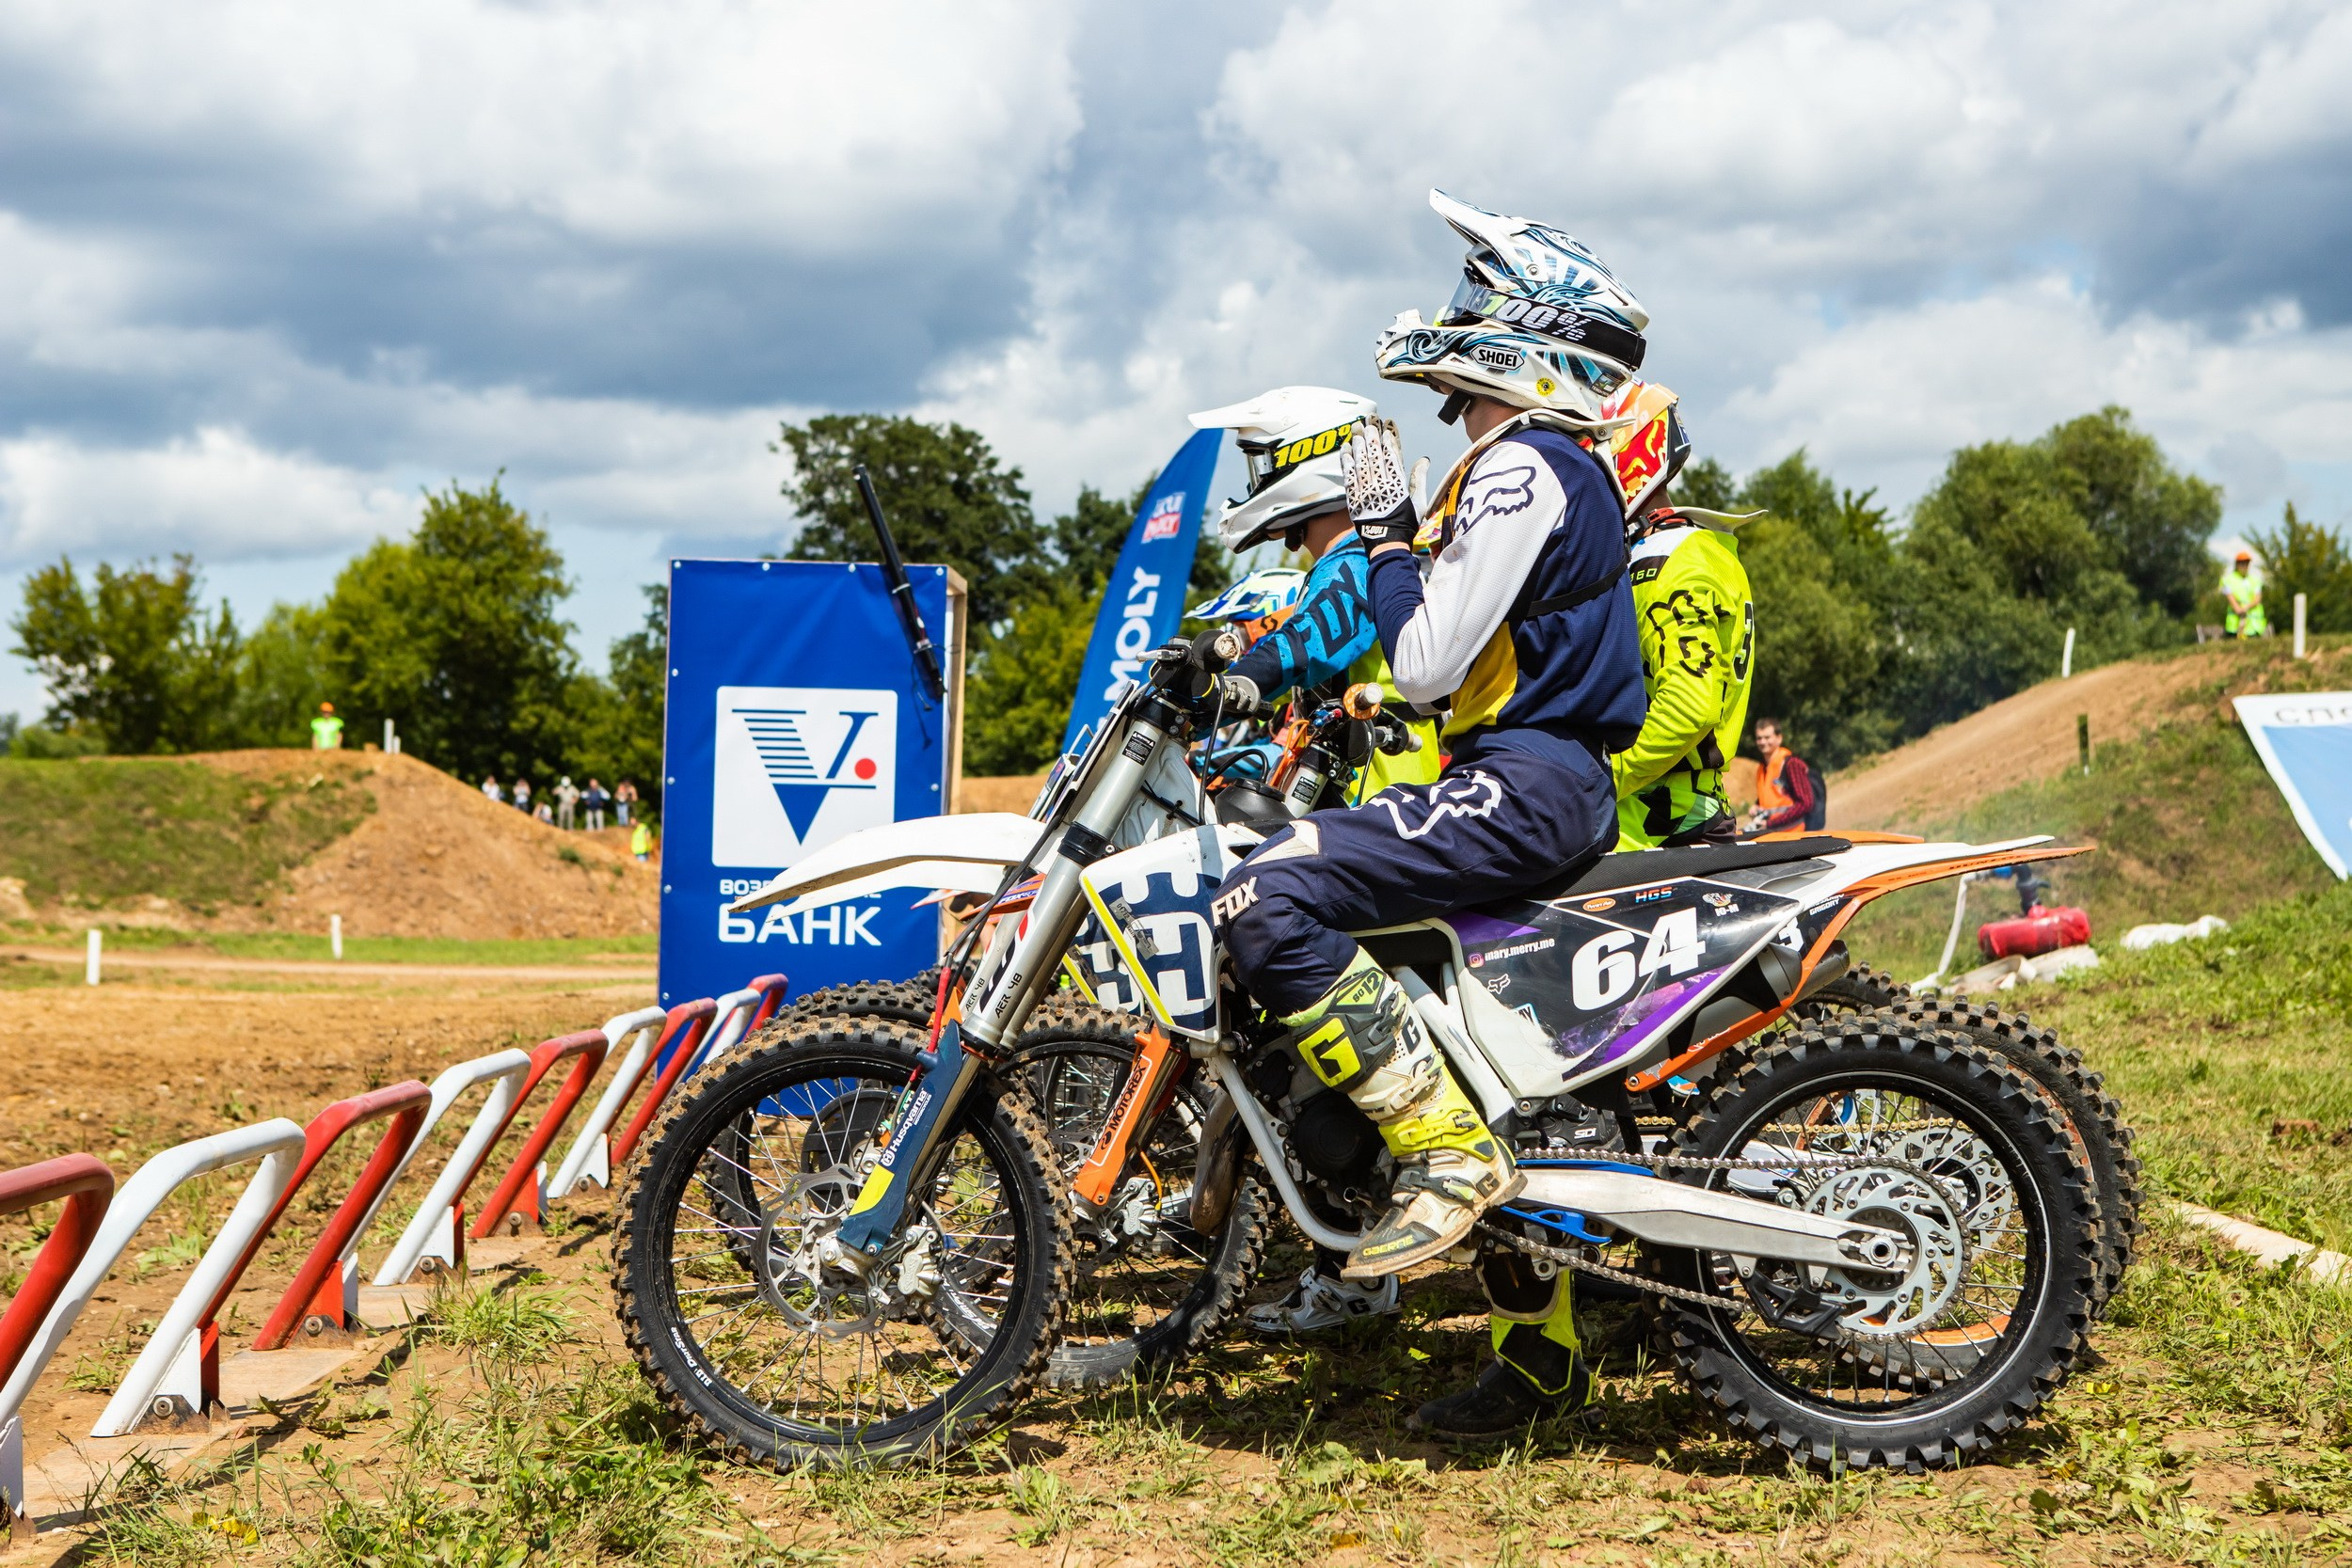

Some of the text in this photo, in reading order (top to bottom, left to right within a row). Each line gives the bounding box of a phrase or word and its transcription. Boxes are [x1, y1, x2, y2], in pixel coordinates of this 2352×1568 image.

[1480, 294, 1592, 341] 100%
[1478, 349, 1518, 368] SHOEI
[1104, 565, 1161, 701] MOLY
[1281, 561, 1374, 677] FOX
[1211, 876, 1260, 927] FOX
[1635, 886, 1673, 903] HGS
[1809, 898, 1840, 916] GRIGORY
[718, 902, 882, 946] БАНК
[1485, 938, 1556, 961] mary.merry.me
[1571, 907, 1707, 1011] 64
[994, 972, 1023, 1019] AER 48
[891, 1089, 929, 1153] Husqvarna
[1109, 1064, 1147, 1131] MOTOREX
